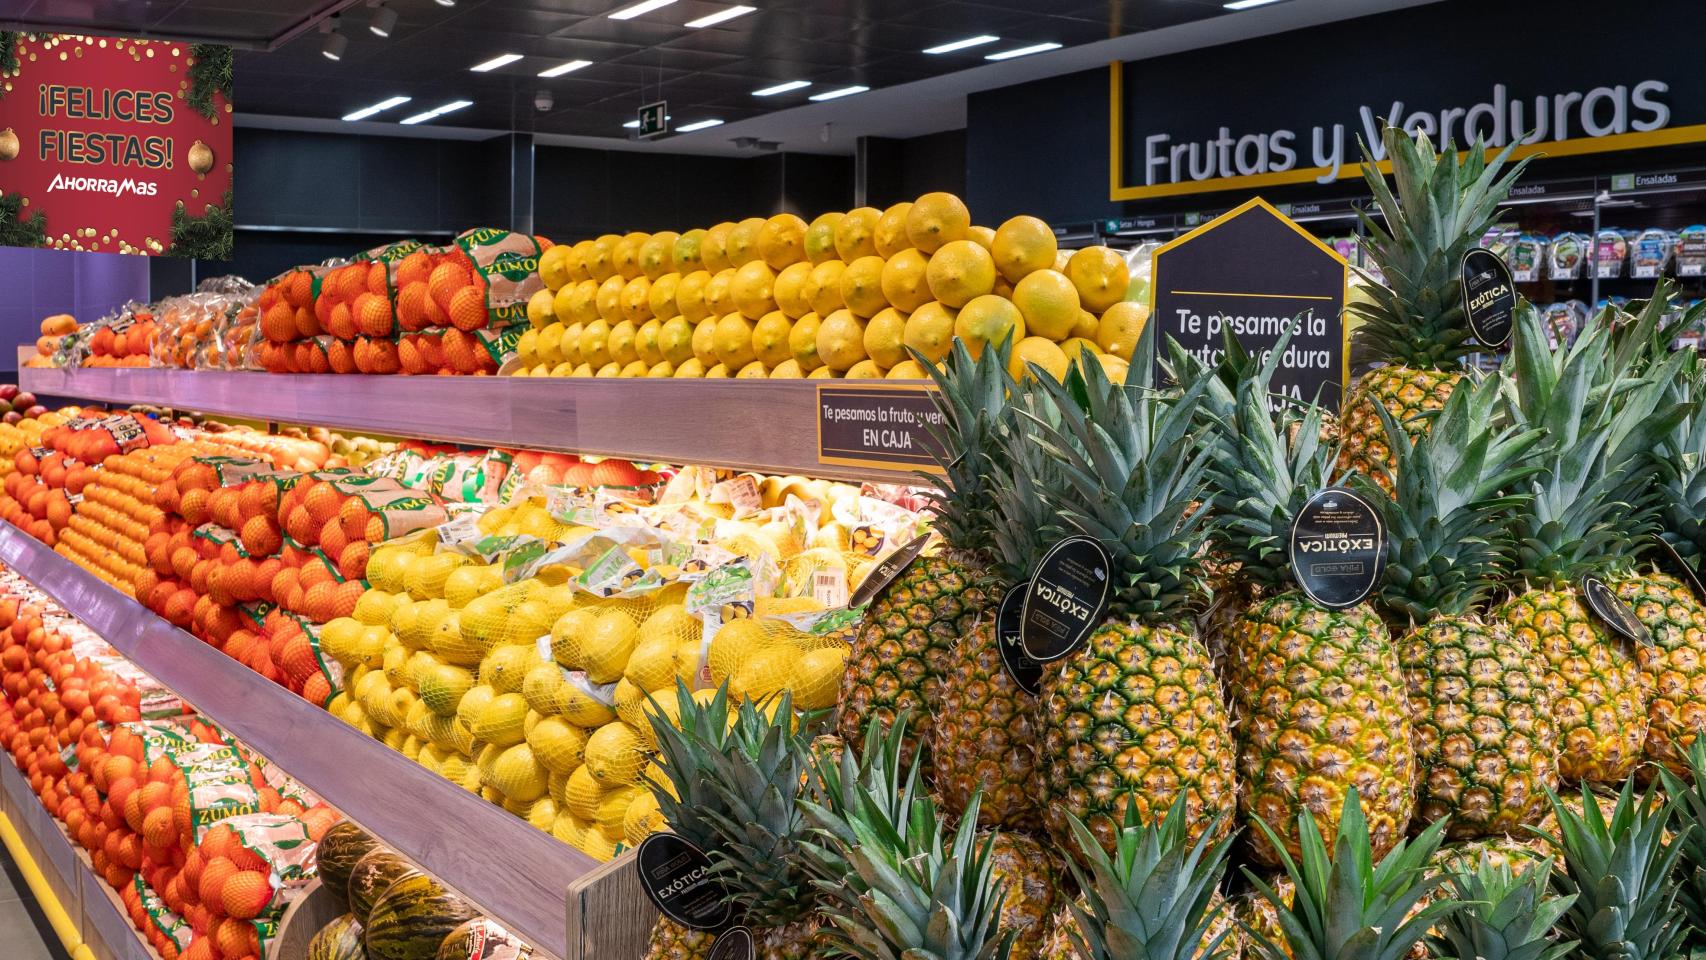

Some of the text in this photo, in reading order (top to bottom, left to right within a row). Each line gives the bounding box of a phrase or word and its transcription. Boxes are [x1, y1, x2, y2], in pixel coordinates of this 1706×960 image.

[38, 83, 174, 124] ¡FELICES
[1145, 80, 1671, 187] Frutas y Verduras
[39, 129, 174, 169] FIESTAS!
[1508, 185, 1545, 197] Ensaladas
[1636, 174, 1678, 186] Ensaladas
[484, 258, 538, 275] ZUMO
[1469, 284, 1508, 311] EXÓTICA
[1176, 308, 1201, 335] Te
[1307, 309, 1326, 337] la
[823, 404, 833, 420] Te
[834, 406, 876, 423] pesamos
[878, 406, 887, 422] la
[889, 406, 914, 423] fruta
[863, 428, 912, 449] EN CAJA
[1299, 537, 1374, 554] EXÓTICA
[1036, 582, 1090, 622] EXÓTICA
[199, 803, 253, 824] ZUMO
[658, 865, 709, 900] EXÓTICA
